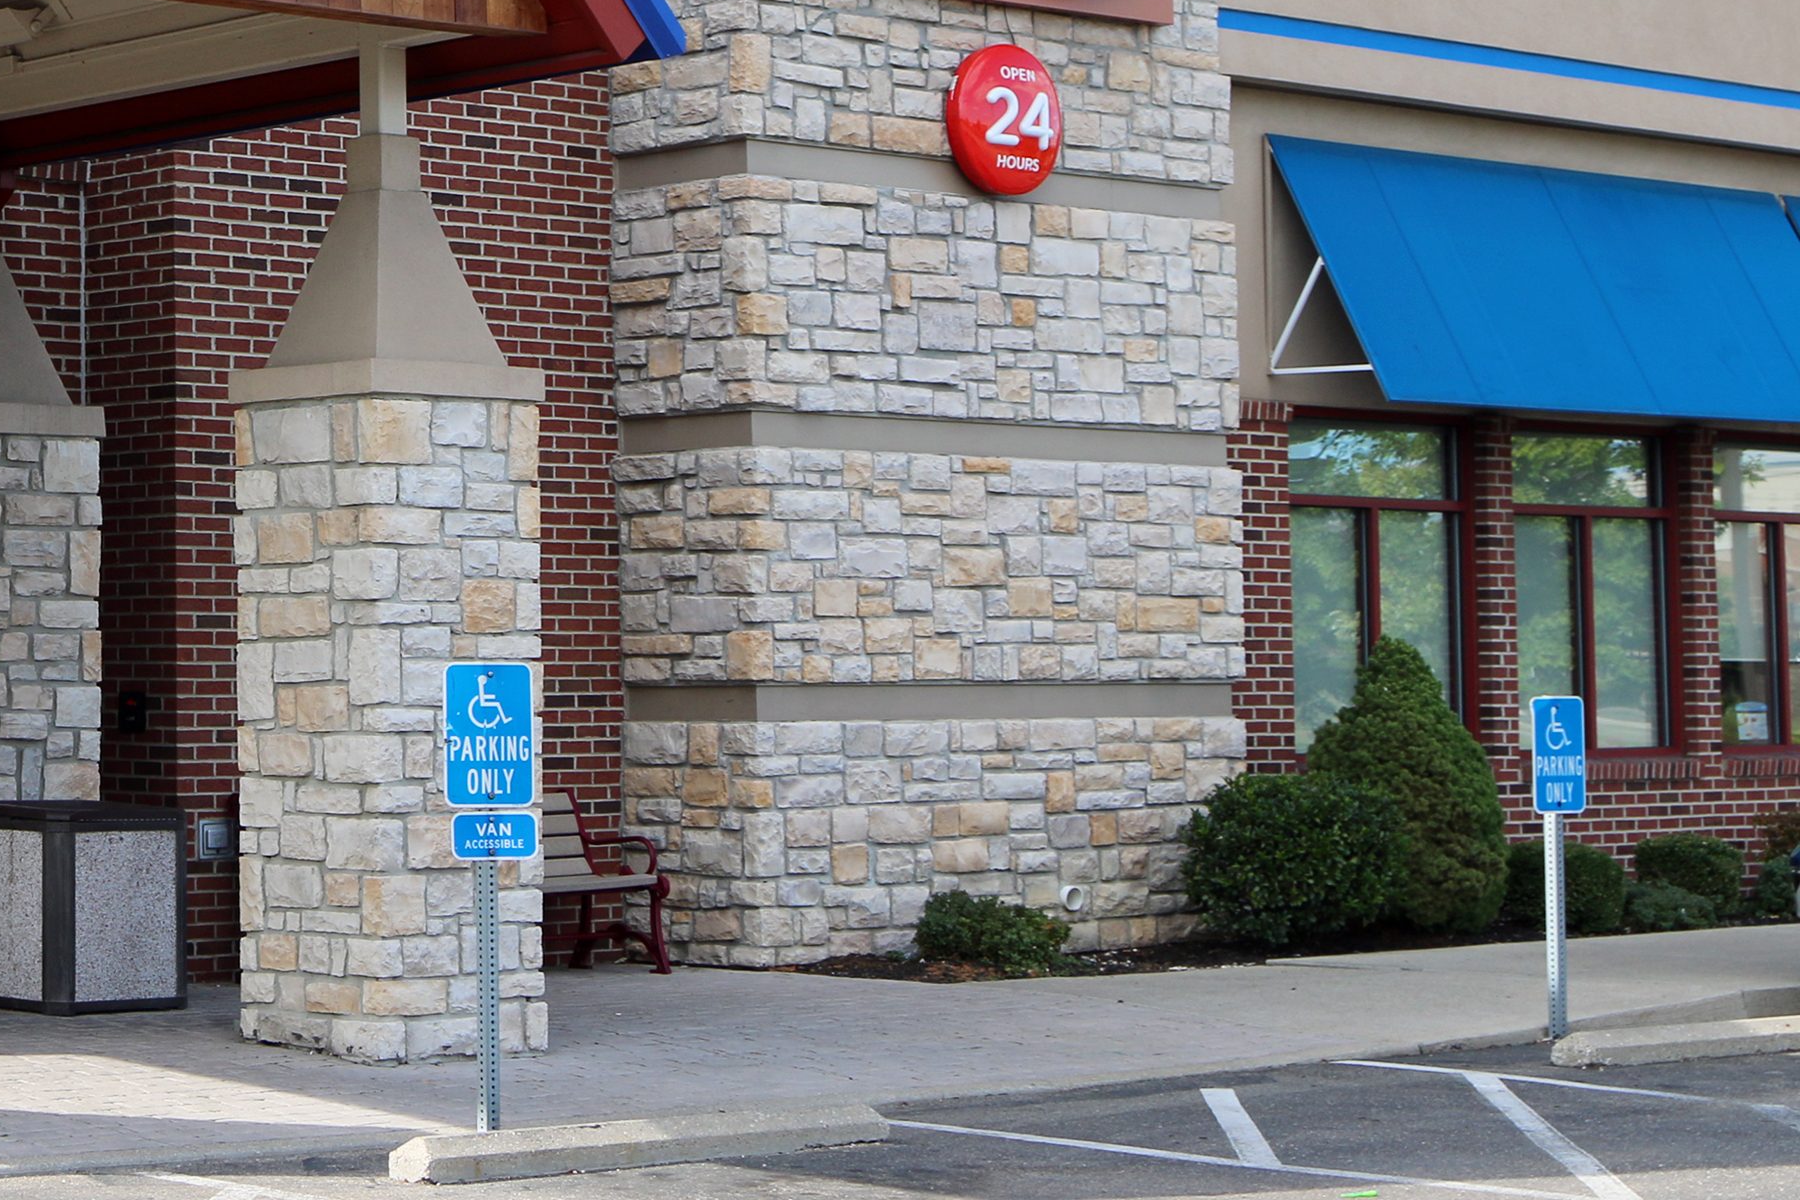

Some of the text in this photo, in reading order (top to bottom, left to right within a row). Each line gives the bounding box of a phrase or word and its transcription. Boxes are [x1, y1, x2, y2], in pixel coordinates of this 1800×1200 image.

[999, 65, 1037, 82] OPEN
[985, 86, 1055, 151] 24
[996, 154, 1041, 173] HOURS
[449, 735, 530, 762] PARKING
[1536, 755, 1583, 777] PARKING
[466, 767, 515, 795] ONLY
[1546, 782, 1574, 804] ONLY
[475, 823, 512, 837] VAN
[464, 839, 525, 850] ACCESSIBLE
